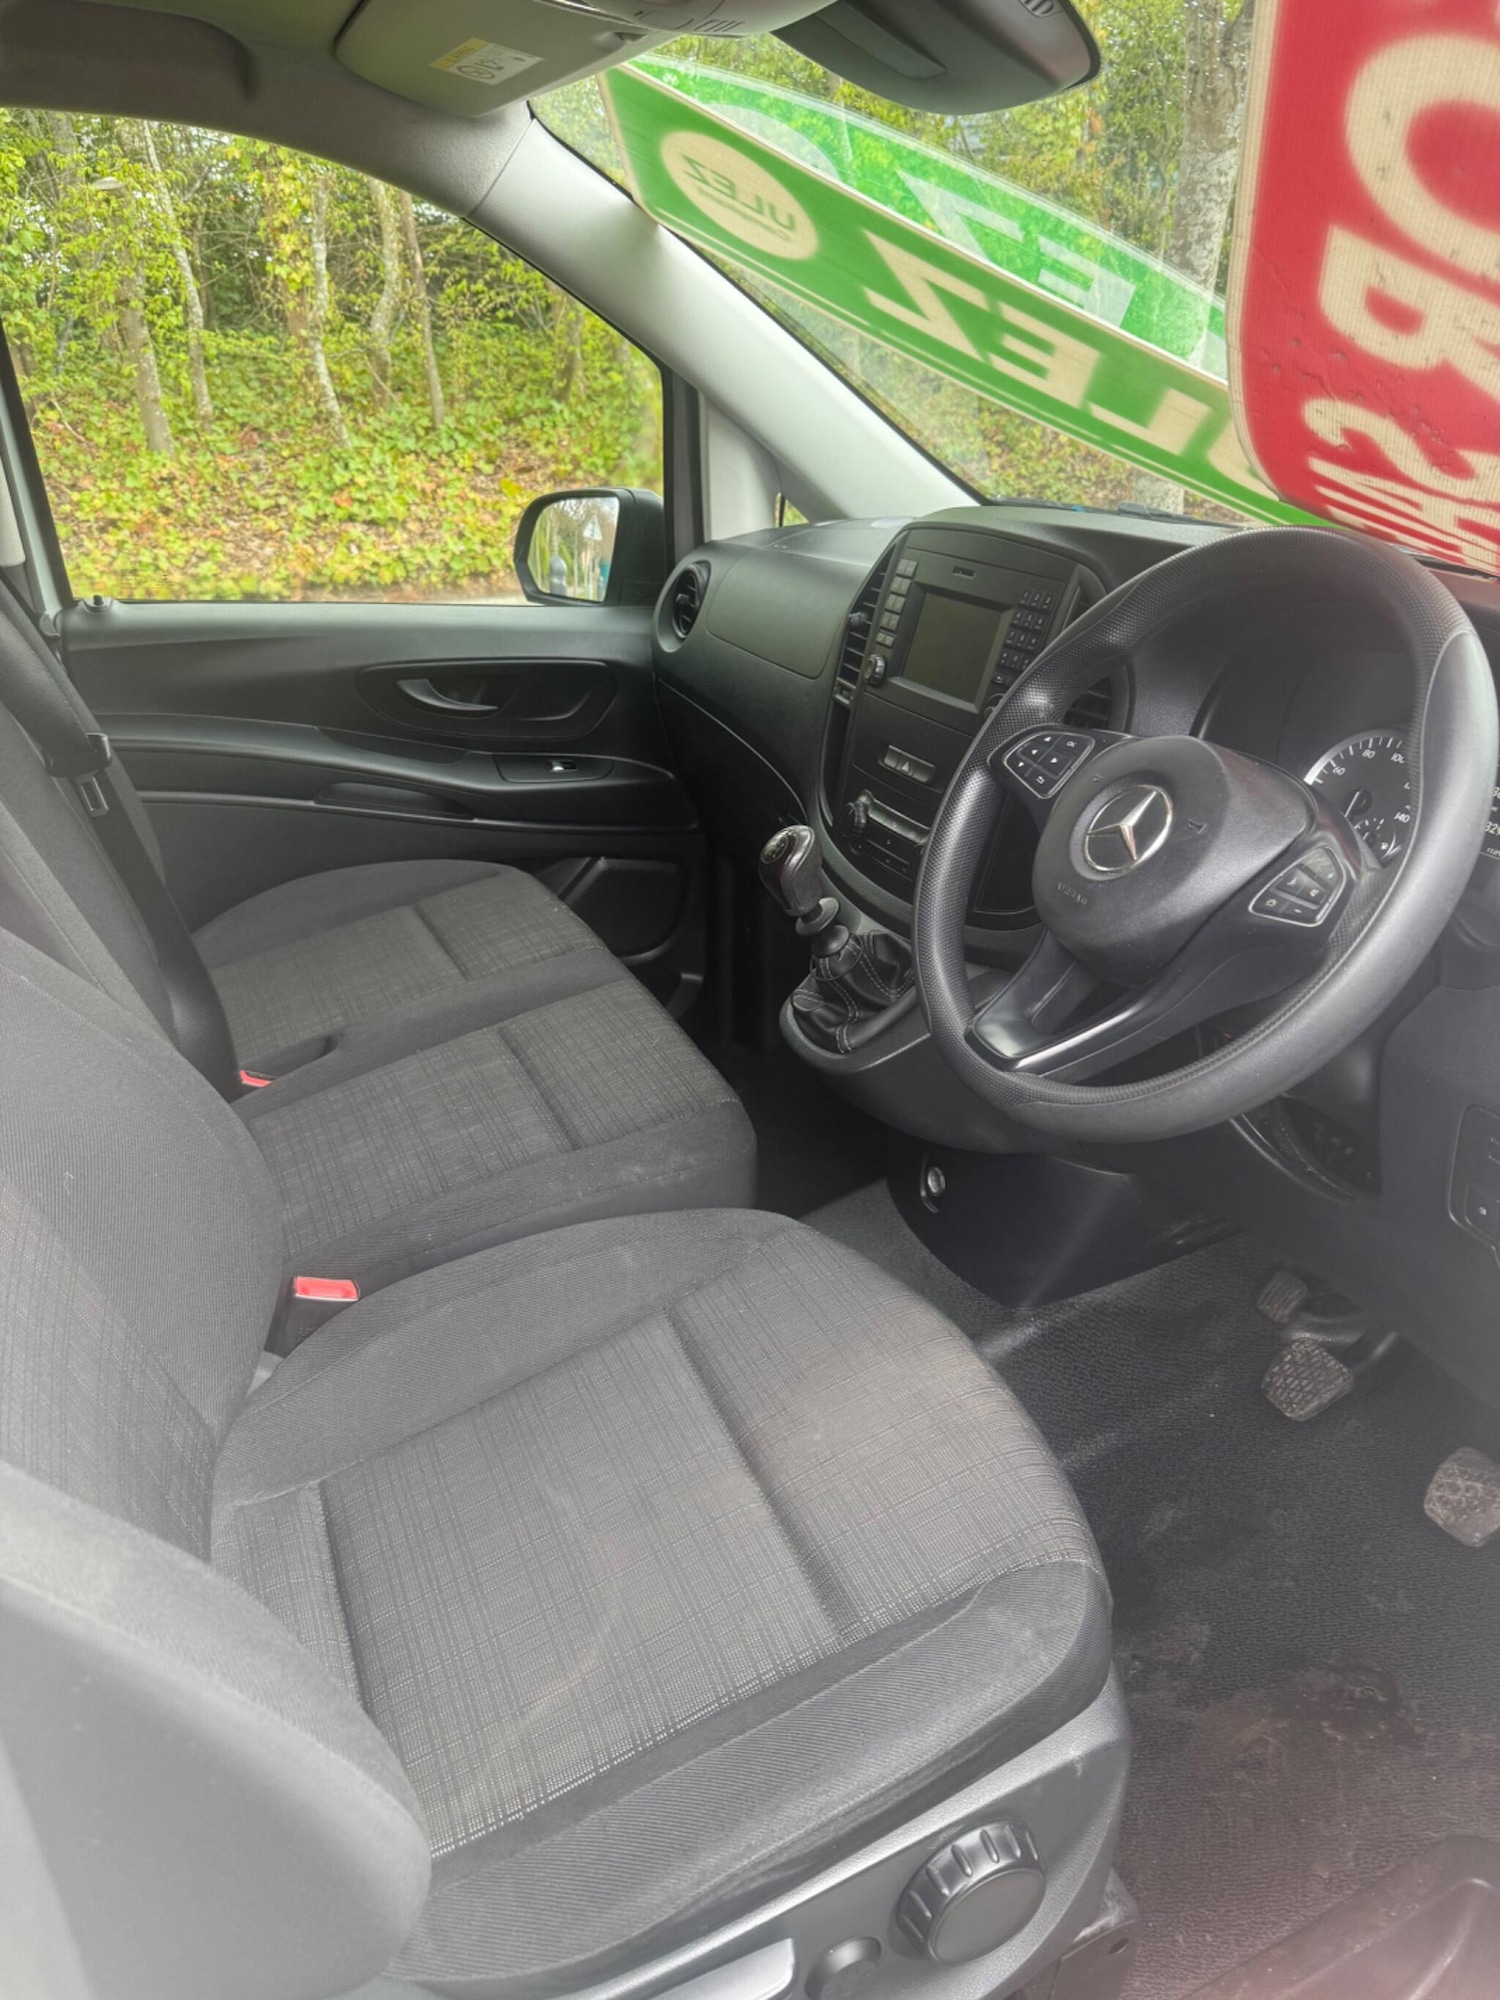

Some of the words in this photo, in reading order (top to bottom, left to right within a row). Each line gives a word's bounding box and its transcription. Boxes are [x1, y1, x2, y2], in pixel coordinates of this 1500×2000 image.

[1361, 749, 1376, 759] 80
[1332, 766, 1346, 776] 60
[1394, 812, 1411, 823] 140
